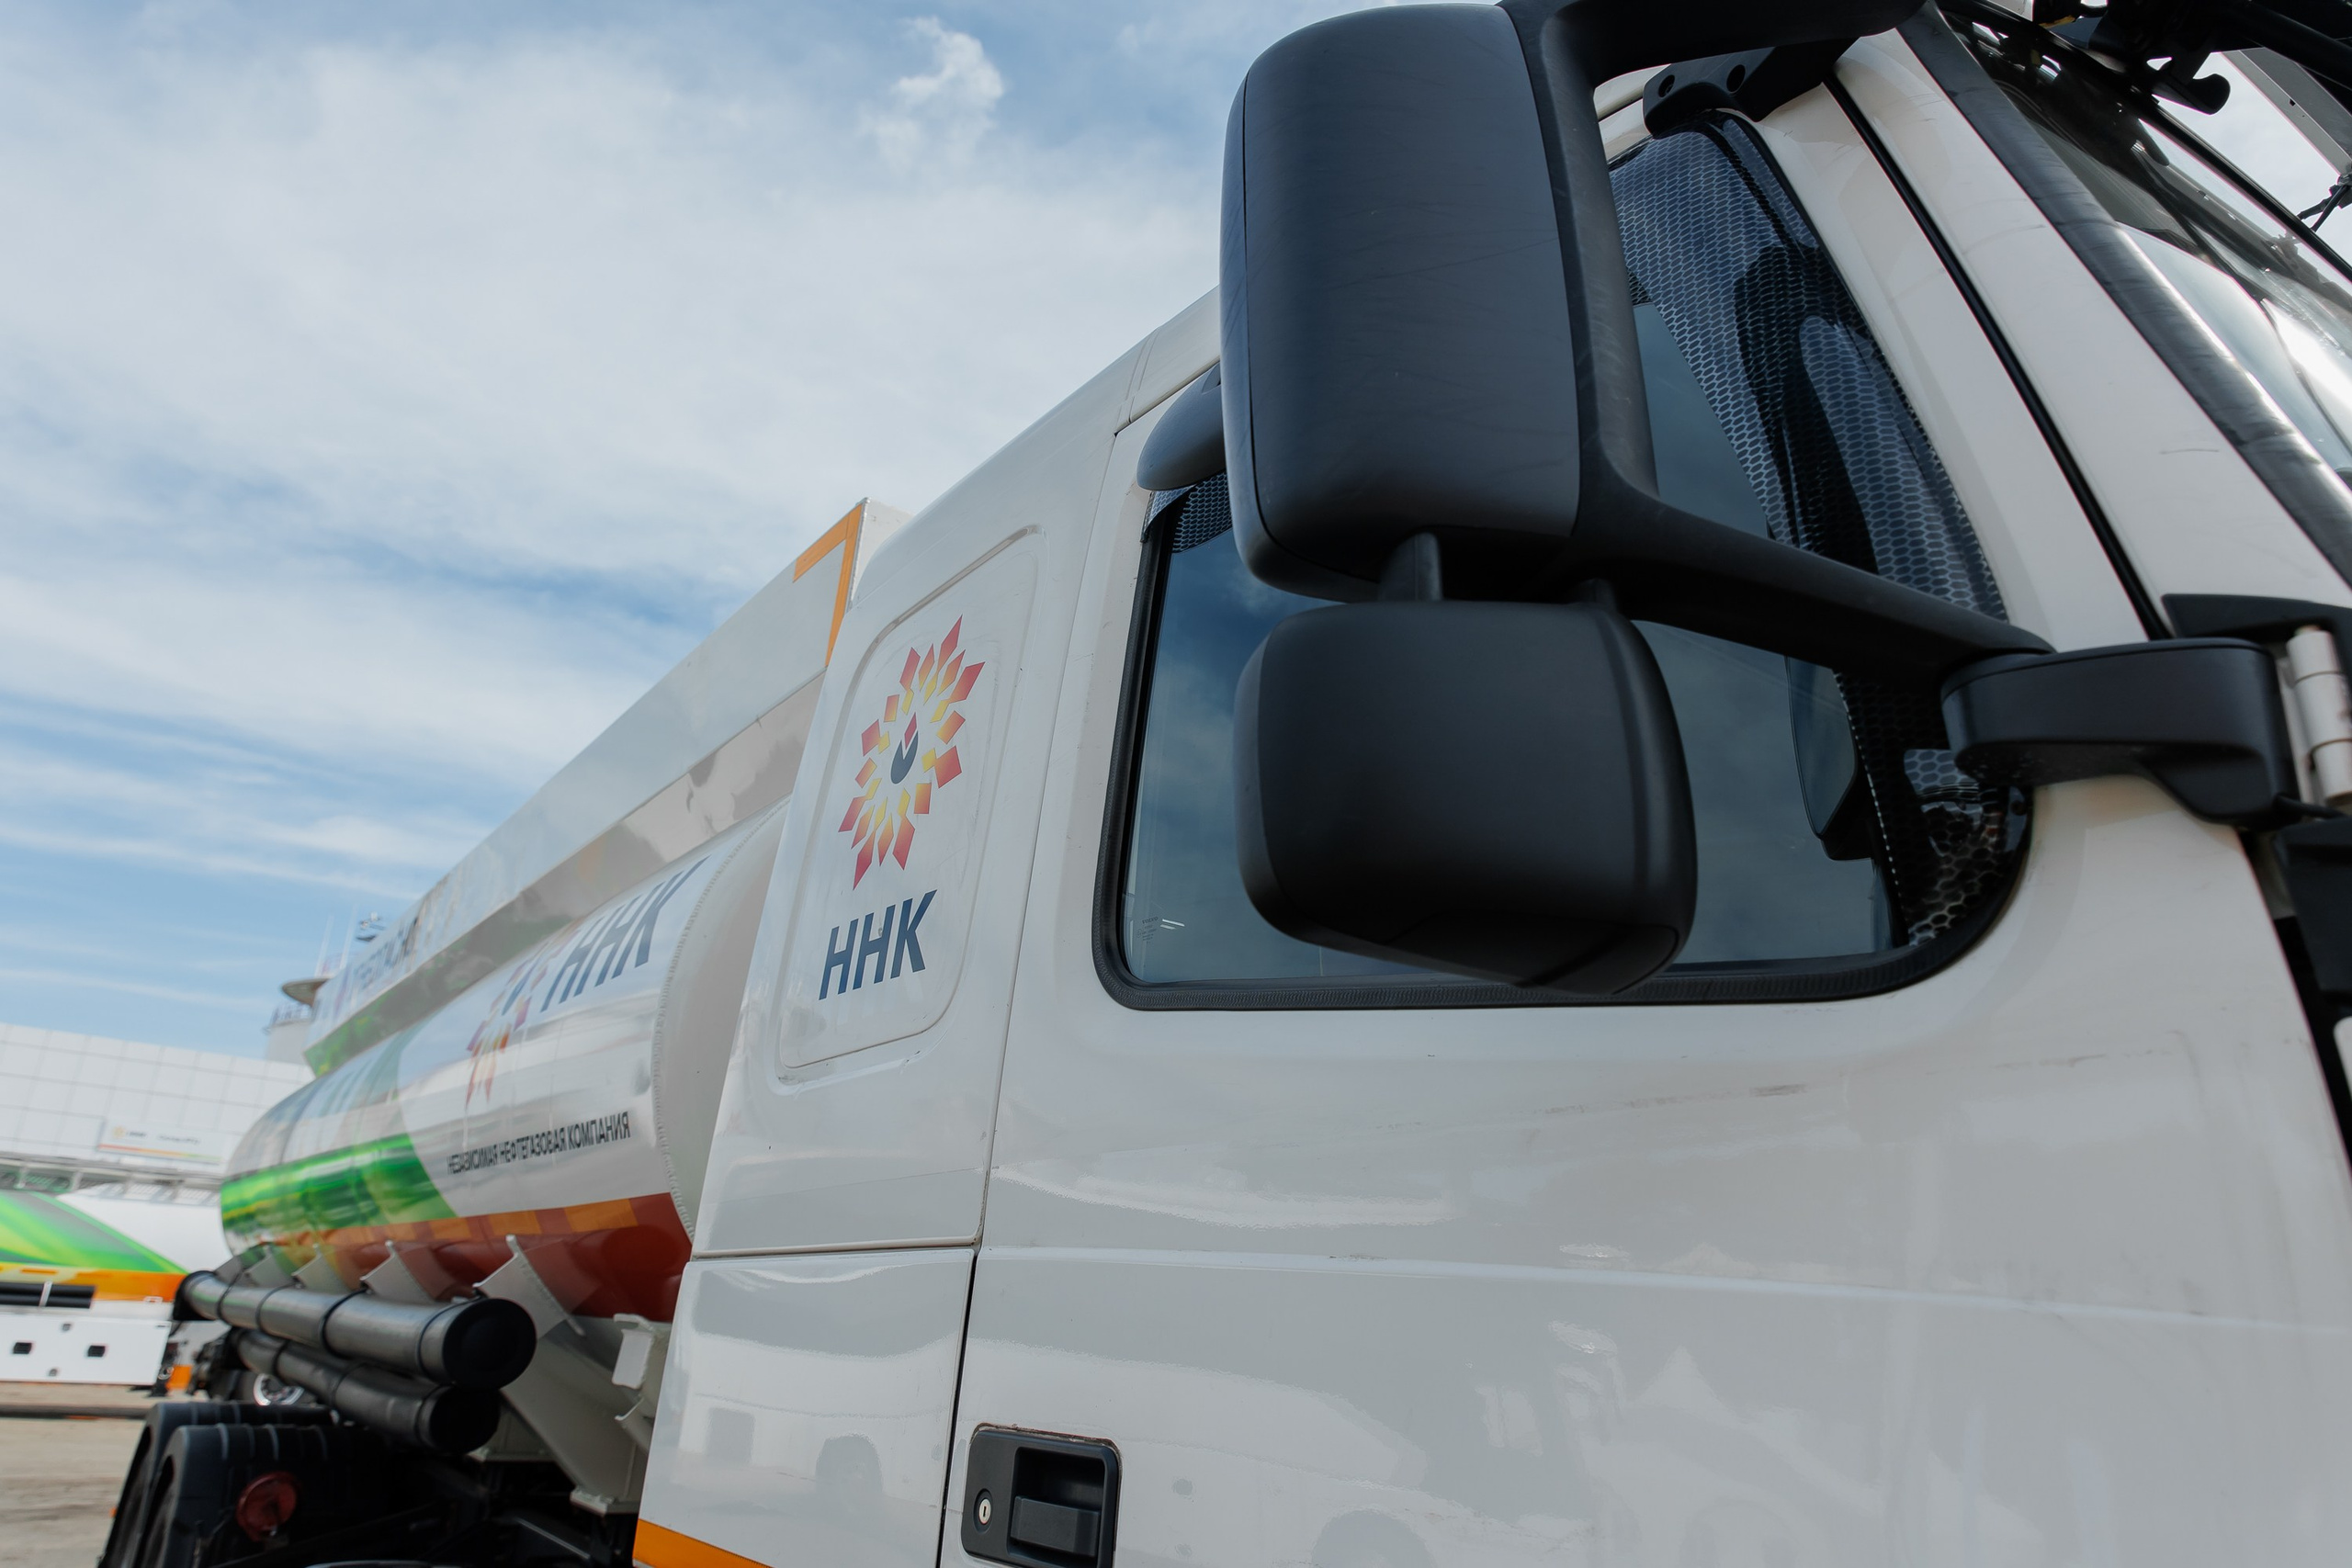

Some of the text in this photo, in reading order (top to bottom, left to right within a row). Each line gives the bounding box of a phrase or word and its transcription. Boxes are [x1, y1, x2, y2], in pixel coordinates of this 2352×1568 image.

[540, 854, 712, 1013] ННК
[819, 889, 938, 1000] ННК
[499, 1127, 566, 1165] НЕФТЕГАЗОВАЯ
[567, 1111, 631, 1150] КОМПАНИЯ
